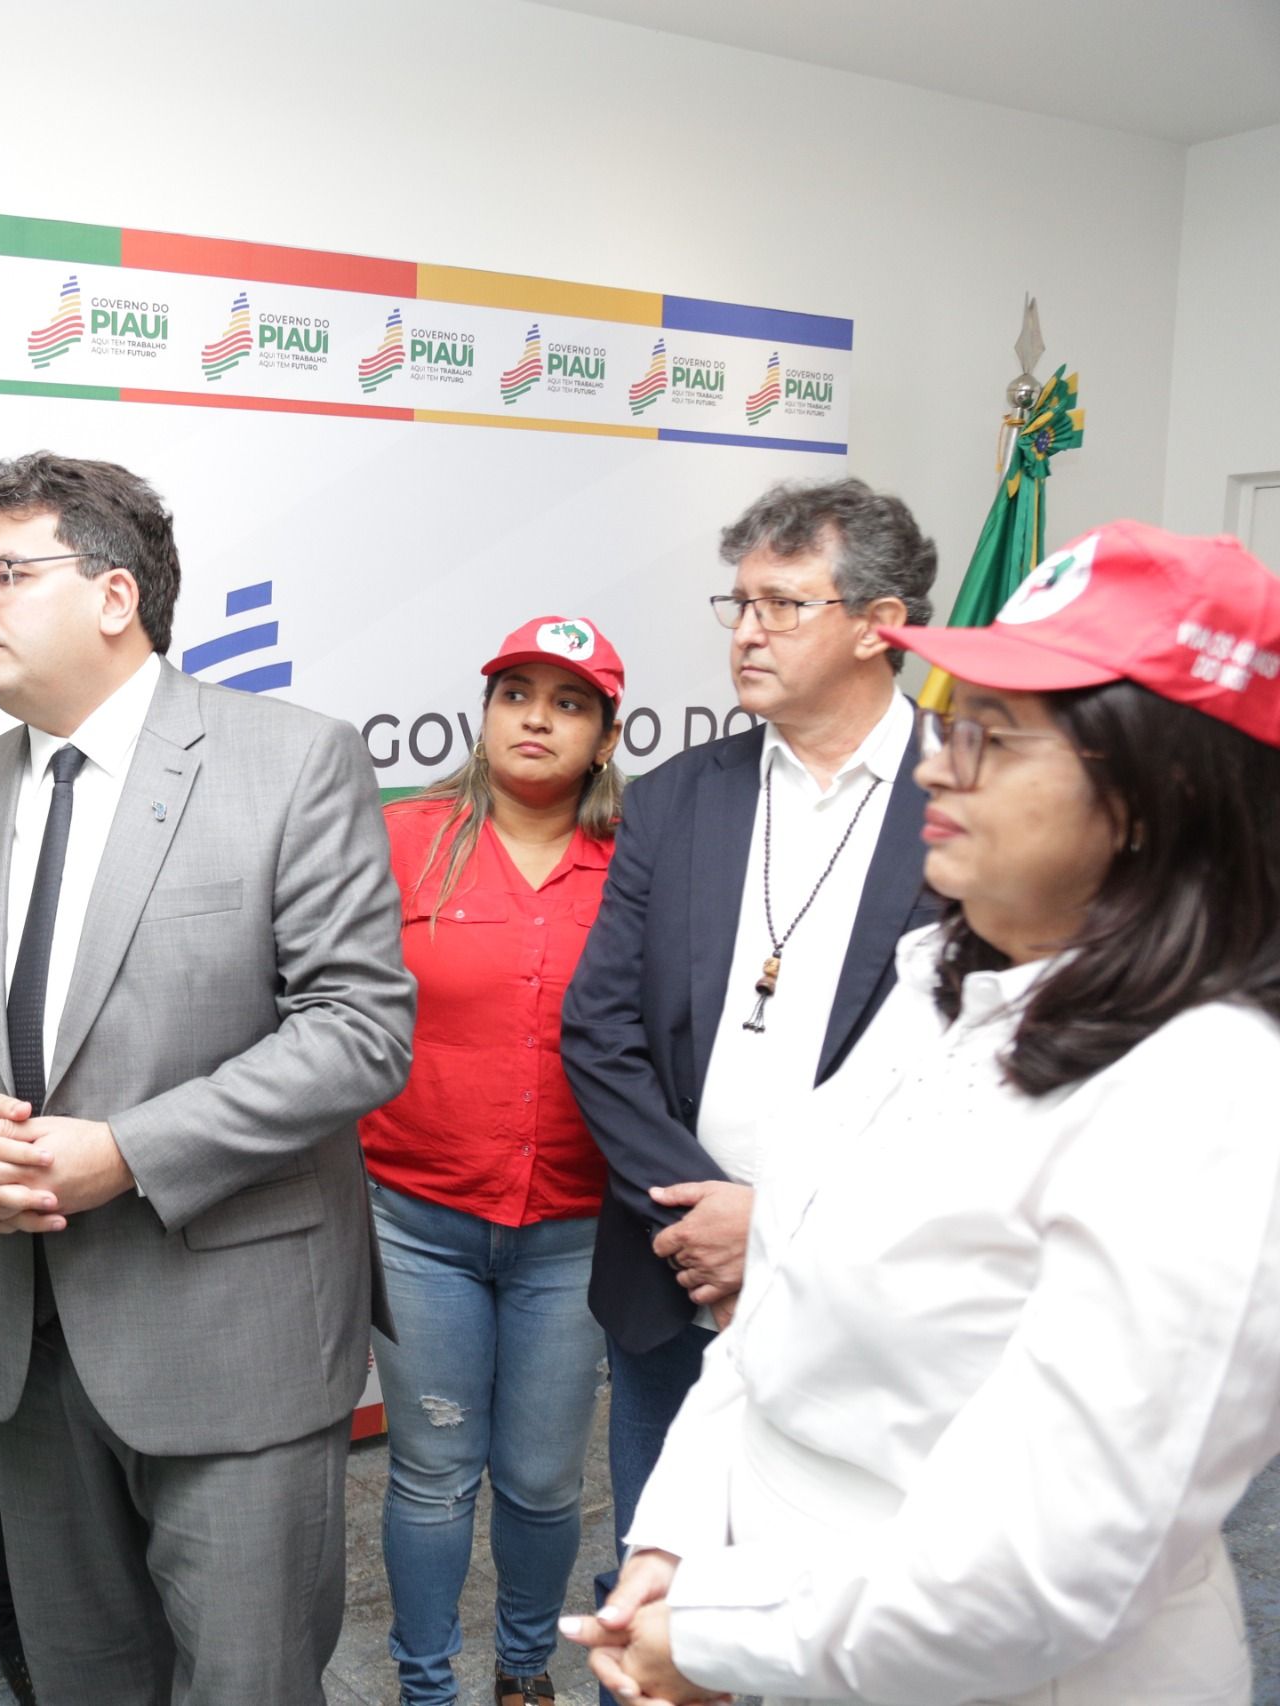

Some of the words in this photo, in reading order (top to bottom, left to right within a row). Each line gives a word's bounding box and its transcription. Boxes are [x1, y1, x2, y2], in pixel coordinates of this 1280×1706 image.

[91, 297, 149, 311] GOVERNO
[152, 303, 169, 313] DO
[91, 309, 168, 340] PIAUÍ
[259, 313, 311, 327] GOVERNO
[314, 318, 330, 329] DO
[91, 337, 109, 345] AQUI
[259, 324, 329, 354] PIAUÍ
[411, 328, 458, 341] GOVERNO
[460, 333, 475, 343] DO
[91, 346, 109, 355] AQUI
[111, 347, 126, 355] TEM
[259, 351, 275, 359] AQUI
[277, 352, 290, 360] TEM
[410, 339, 474, 368] PIAUÍ
[548, 343, 591, 356] GOVERNO
[593, 347, 606, 357] DO
[259, 360, 275, 368] AQUI
[547, 352, 606, 380] PIAUÍ
[672, 356, 712, 368] GOVERNO
[714, 360, 726, 370] DO
[672, 366, 724, 392] PIAUÍ
[785, 378, 833, 403] PIAUÍ
